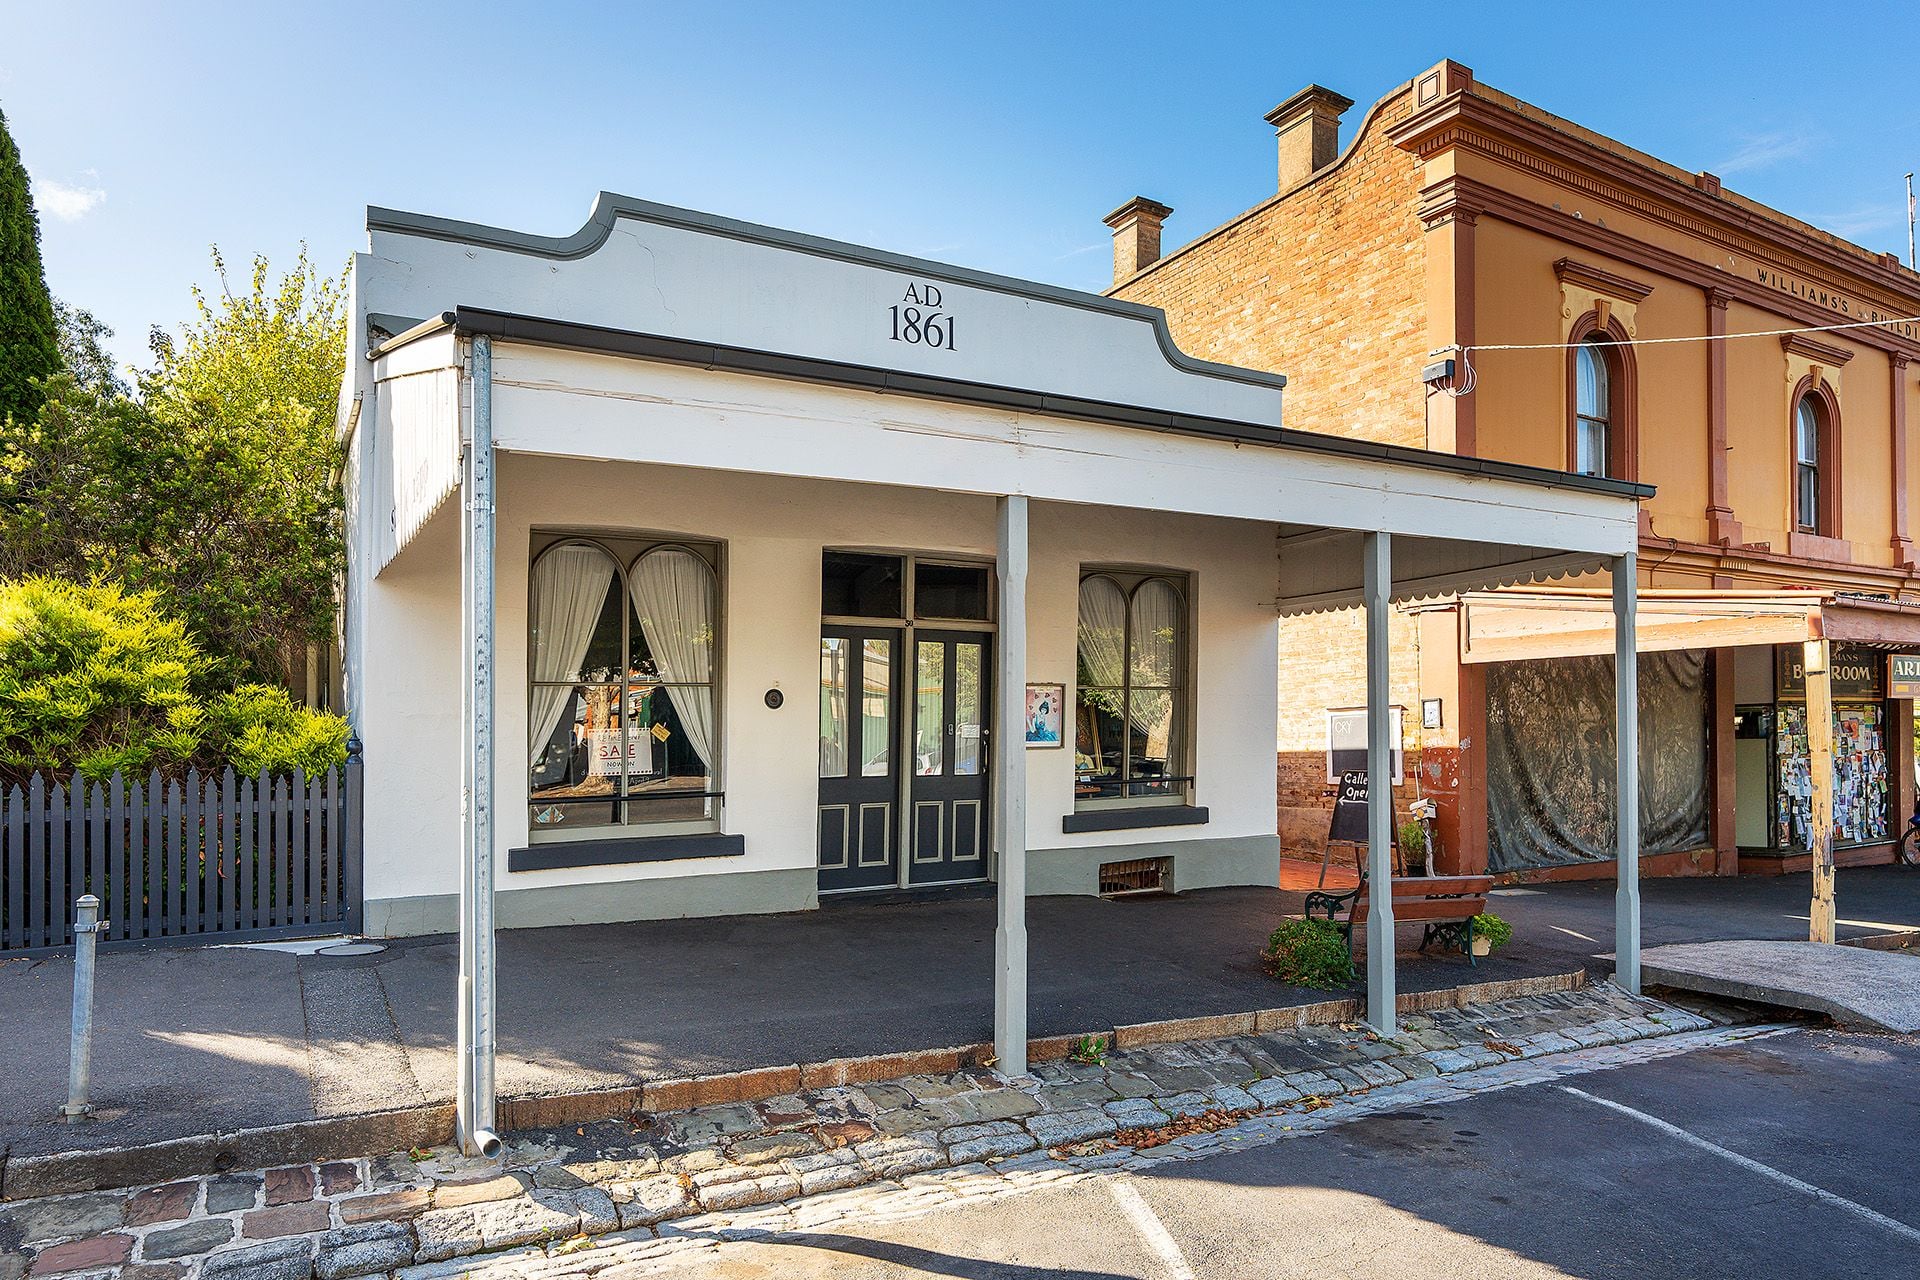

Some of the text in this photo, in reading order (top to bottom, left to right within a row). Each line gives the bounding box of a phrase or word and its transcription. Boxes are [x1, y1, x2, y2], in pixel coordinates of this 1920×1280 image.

[903, 282, 943, 308] A.D.
[1757, 268, 1849, 312] WILLIAMS'S
[888, 305, 957, 351] 1861
[600, 744, 636, 757] SAE
